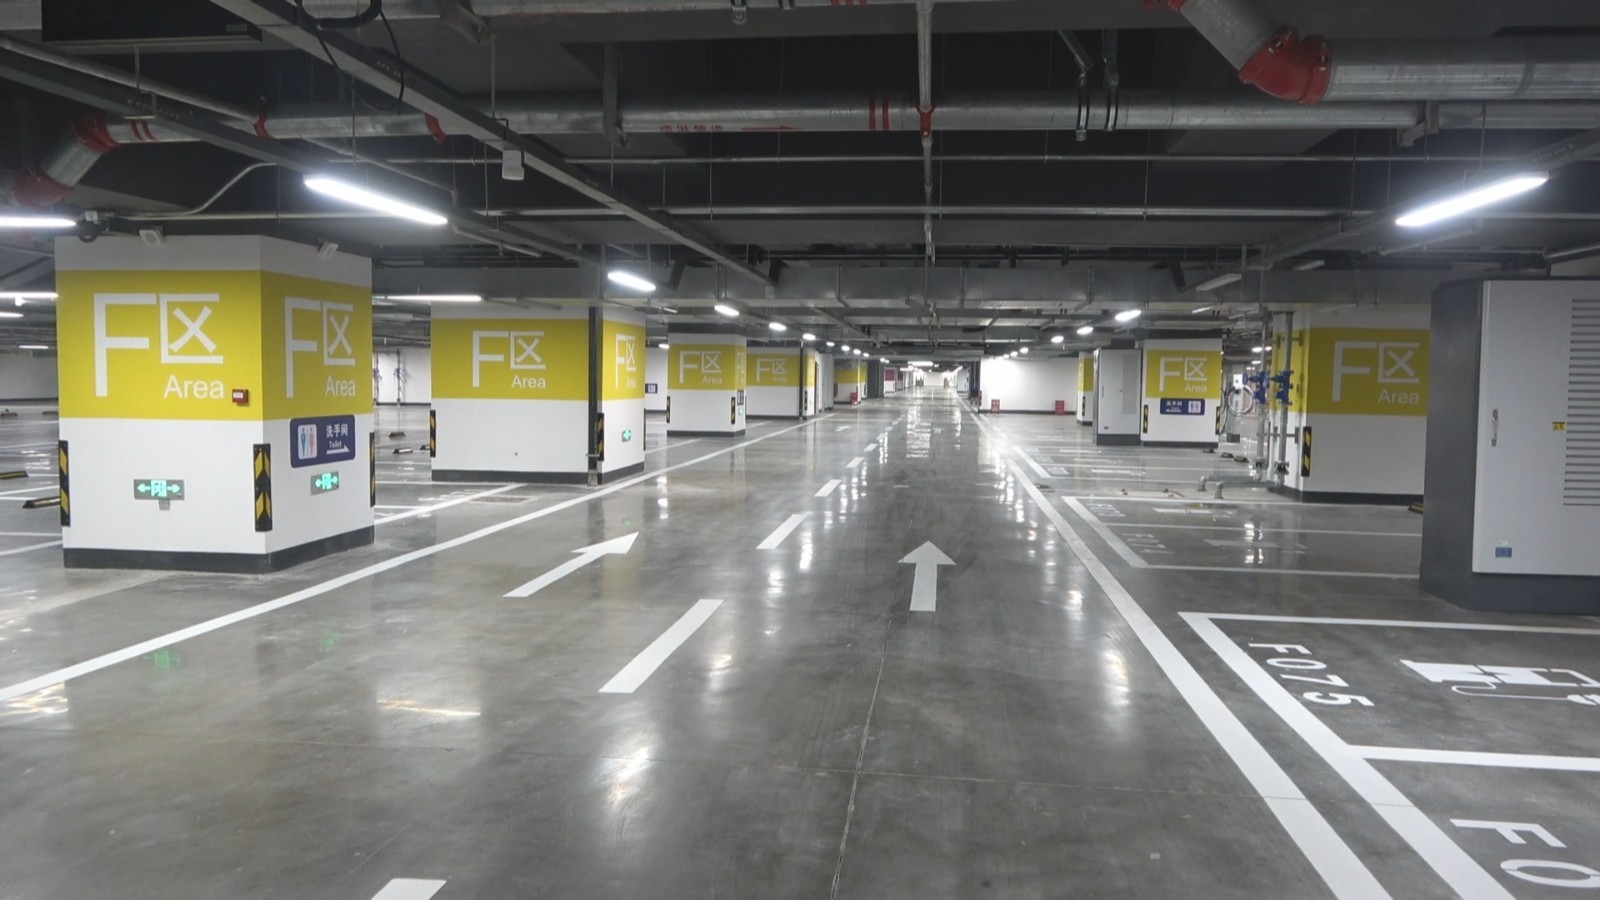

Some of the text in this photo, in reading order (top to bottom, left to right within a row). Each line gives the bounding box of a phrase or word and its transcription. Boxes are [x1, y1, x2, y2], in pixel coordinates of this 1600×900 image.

[163, 374, 225, 399] Area
[325, 375, 356, 397] Area
[511, 375, 546, 388] Area
[702, 375, 722, 384] Area
[1184, 383, 1207, 393] Area
[1378, 388, 1420, 404] Area
[326, 424, 348, 438] 洗手间
[329, 441, 342, 449] Toilet
[1248, 642, 1375, 707] F075
